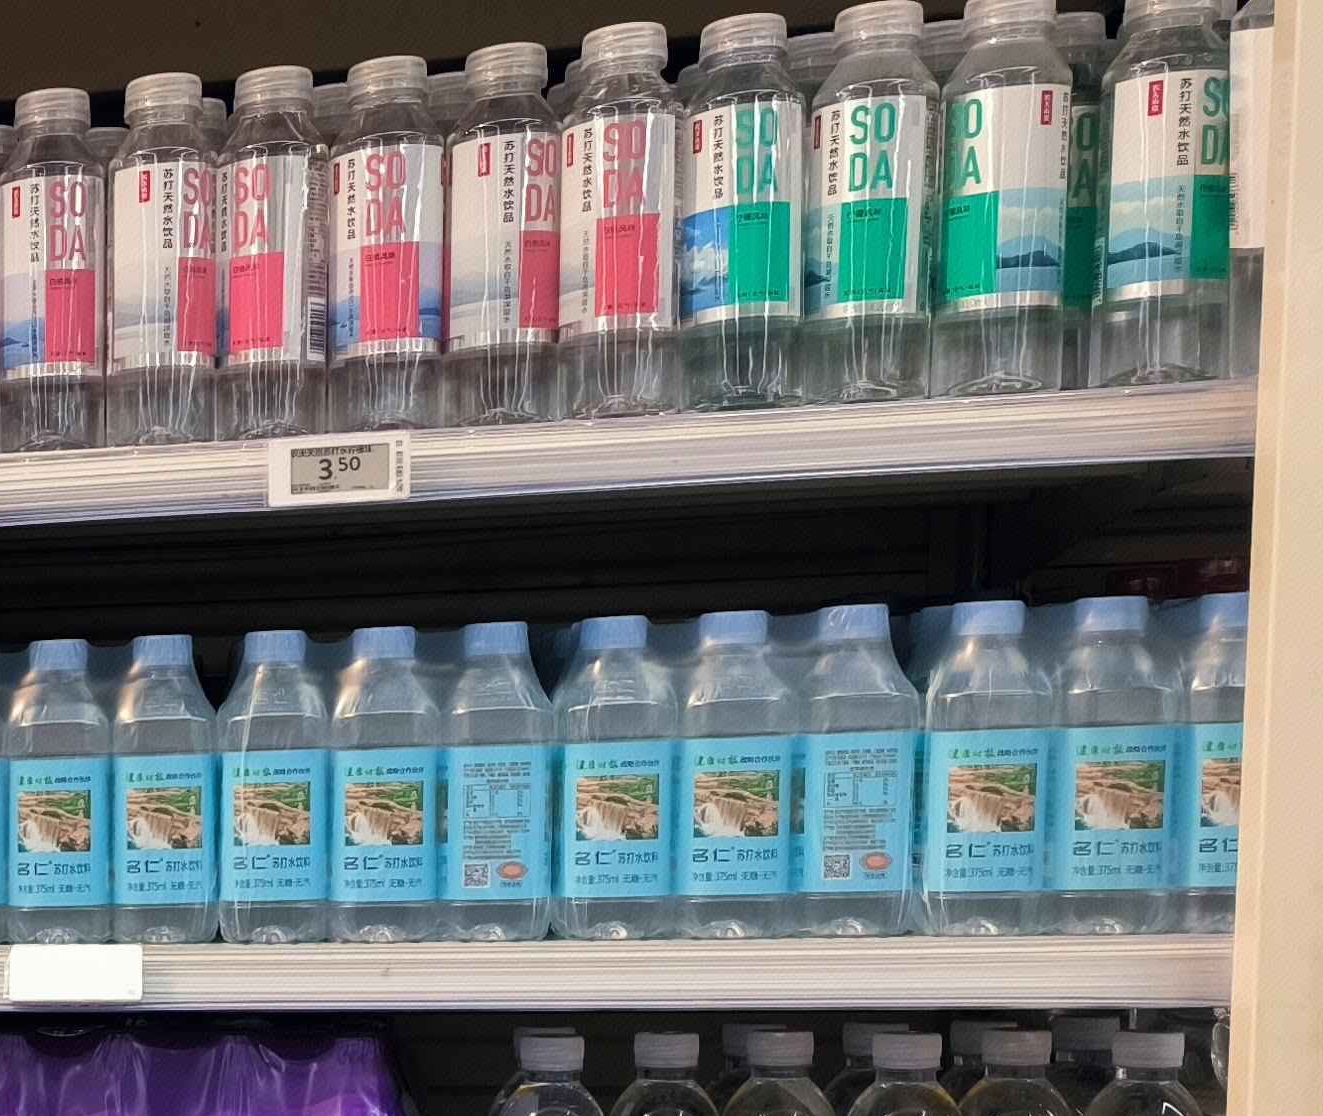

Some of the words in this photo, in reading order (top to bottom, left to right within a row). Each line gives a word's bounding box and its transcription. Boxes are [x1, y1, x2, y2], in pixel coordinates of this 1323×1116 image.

[849, 101, 896, 143] SO
[1175, 77, 1191, 167] 苏打天然水饮品
[365, 150, 407, 192] SO
[503, 140, 514, 224] 苏打天然水饮品
[847, 150, 893, 192] DA
[48, 180, 87, 219] SO
[163, 167, 173, 249] 苏打天然水饮品
[365, 195, 406, 239] DA
